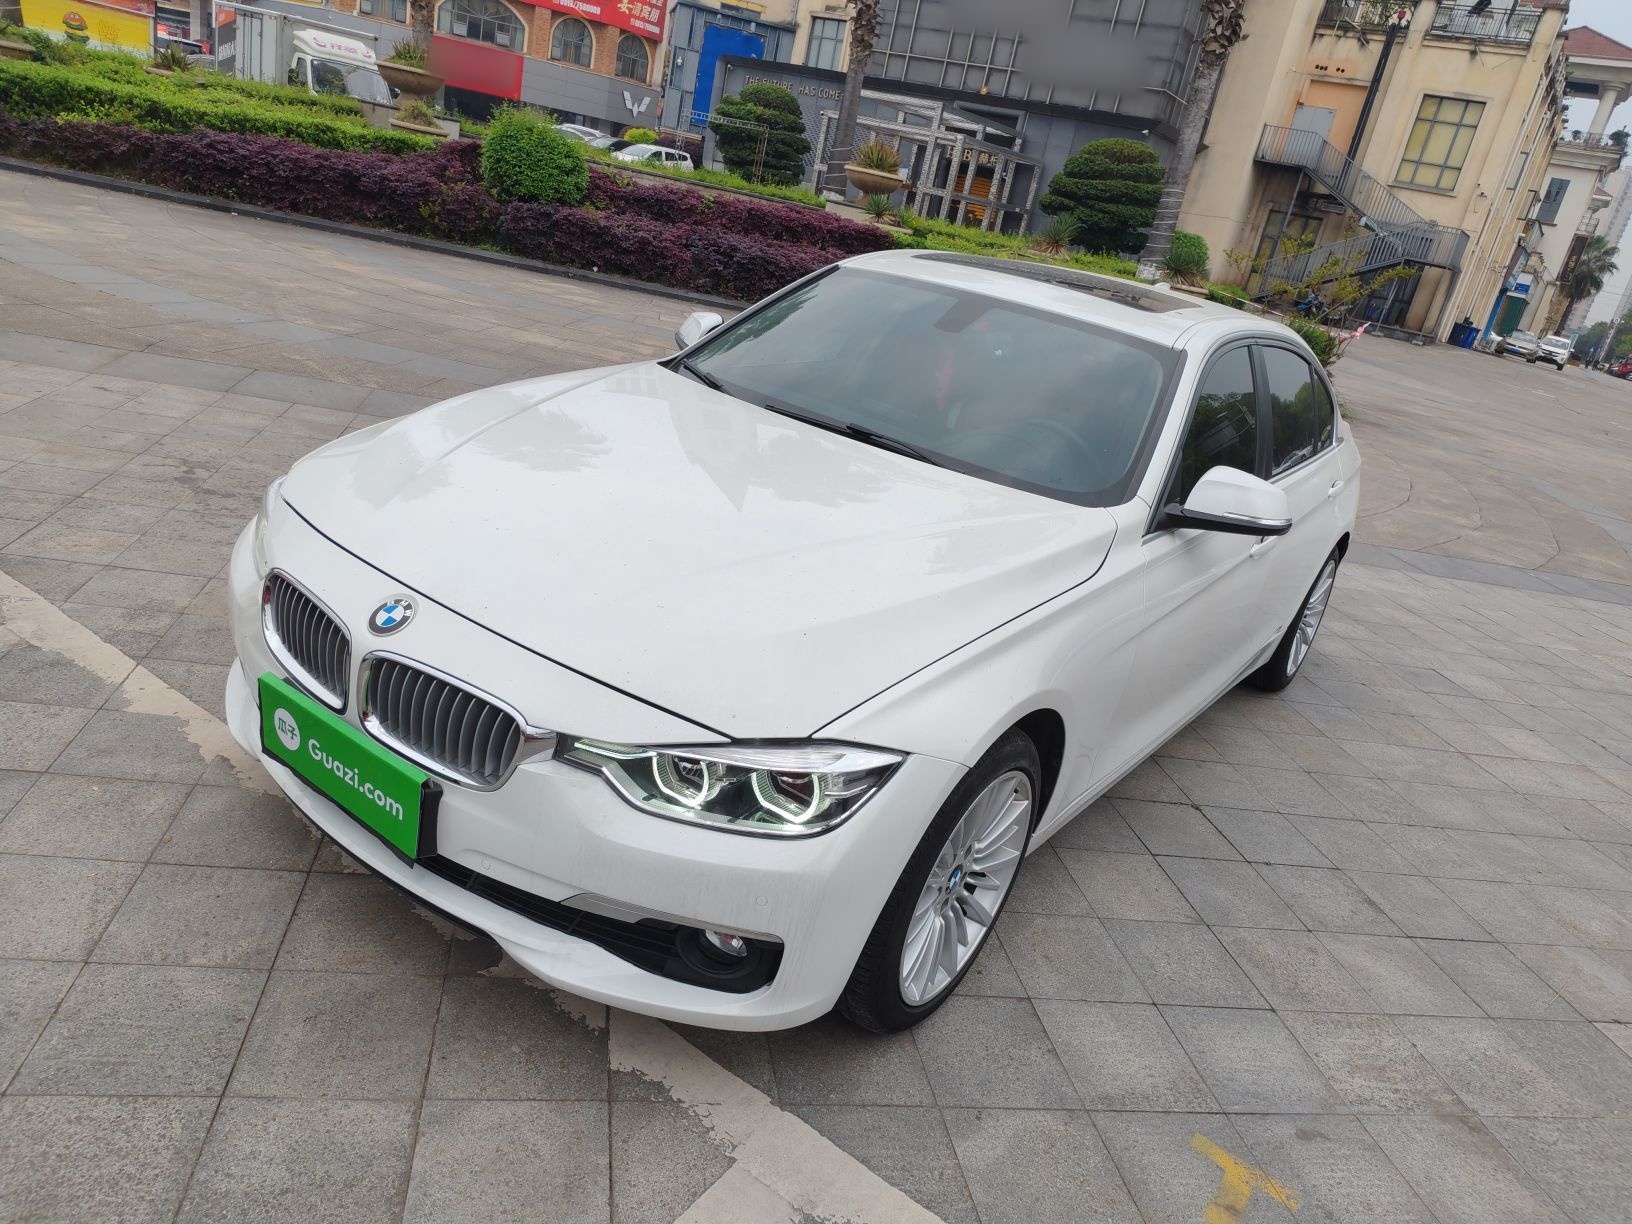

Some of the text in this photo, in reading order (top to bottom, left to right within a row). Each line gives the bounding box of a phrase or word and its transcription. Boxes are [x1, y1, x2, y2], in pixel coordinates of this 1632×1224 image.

[744, 75, 760, 85] THE
[798, 84, 816, 96] HAS
[818, 87, 840, 100] COME
[278, 717, 298, 741] 瓜子
[308, 738, 403, 821] Guazi.com
